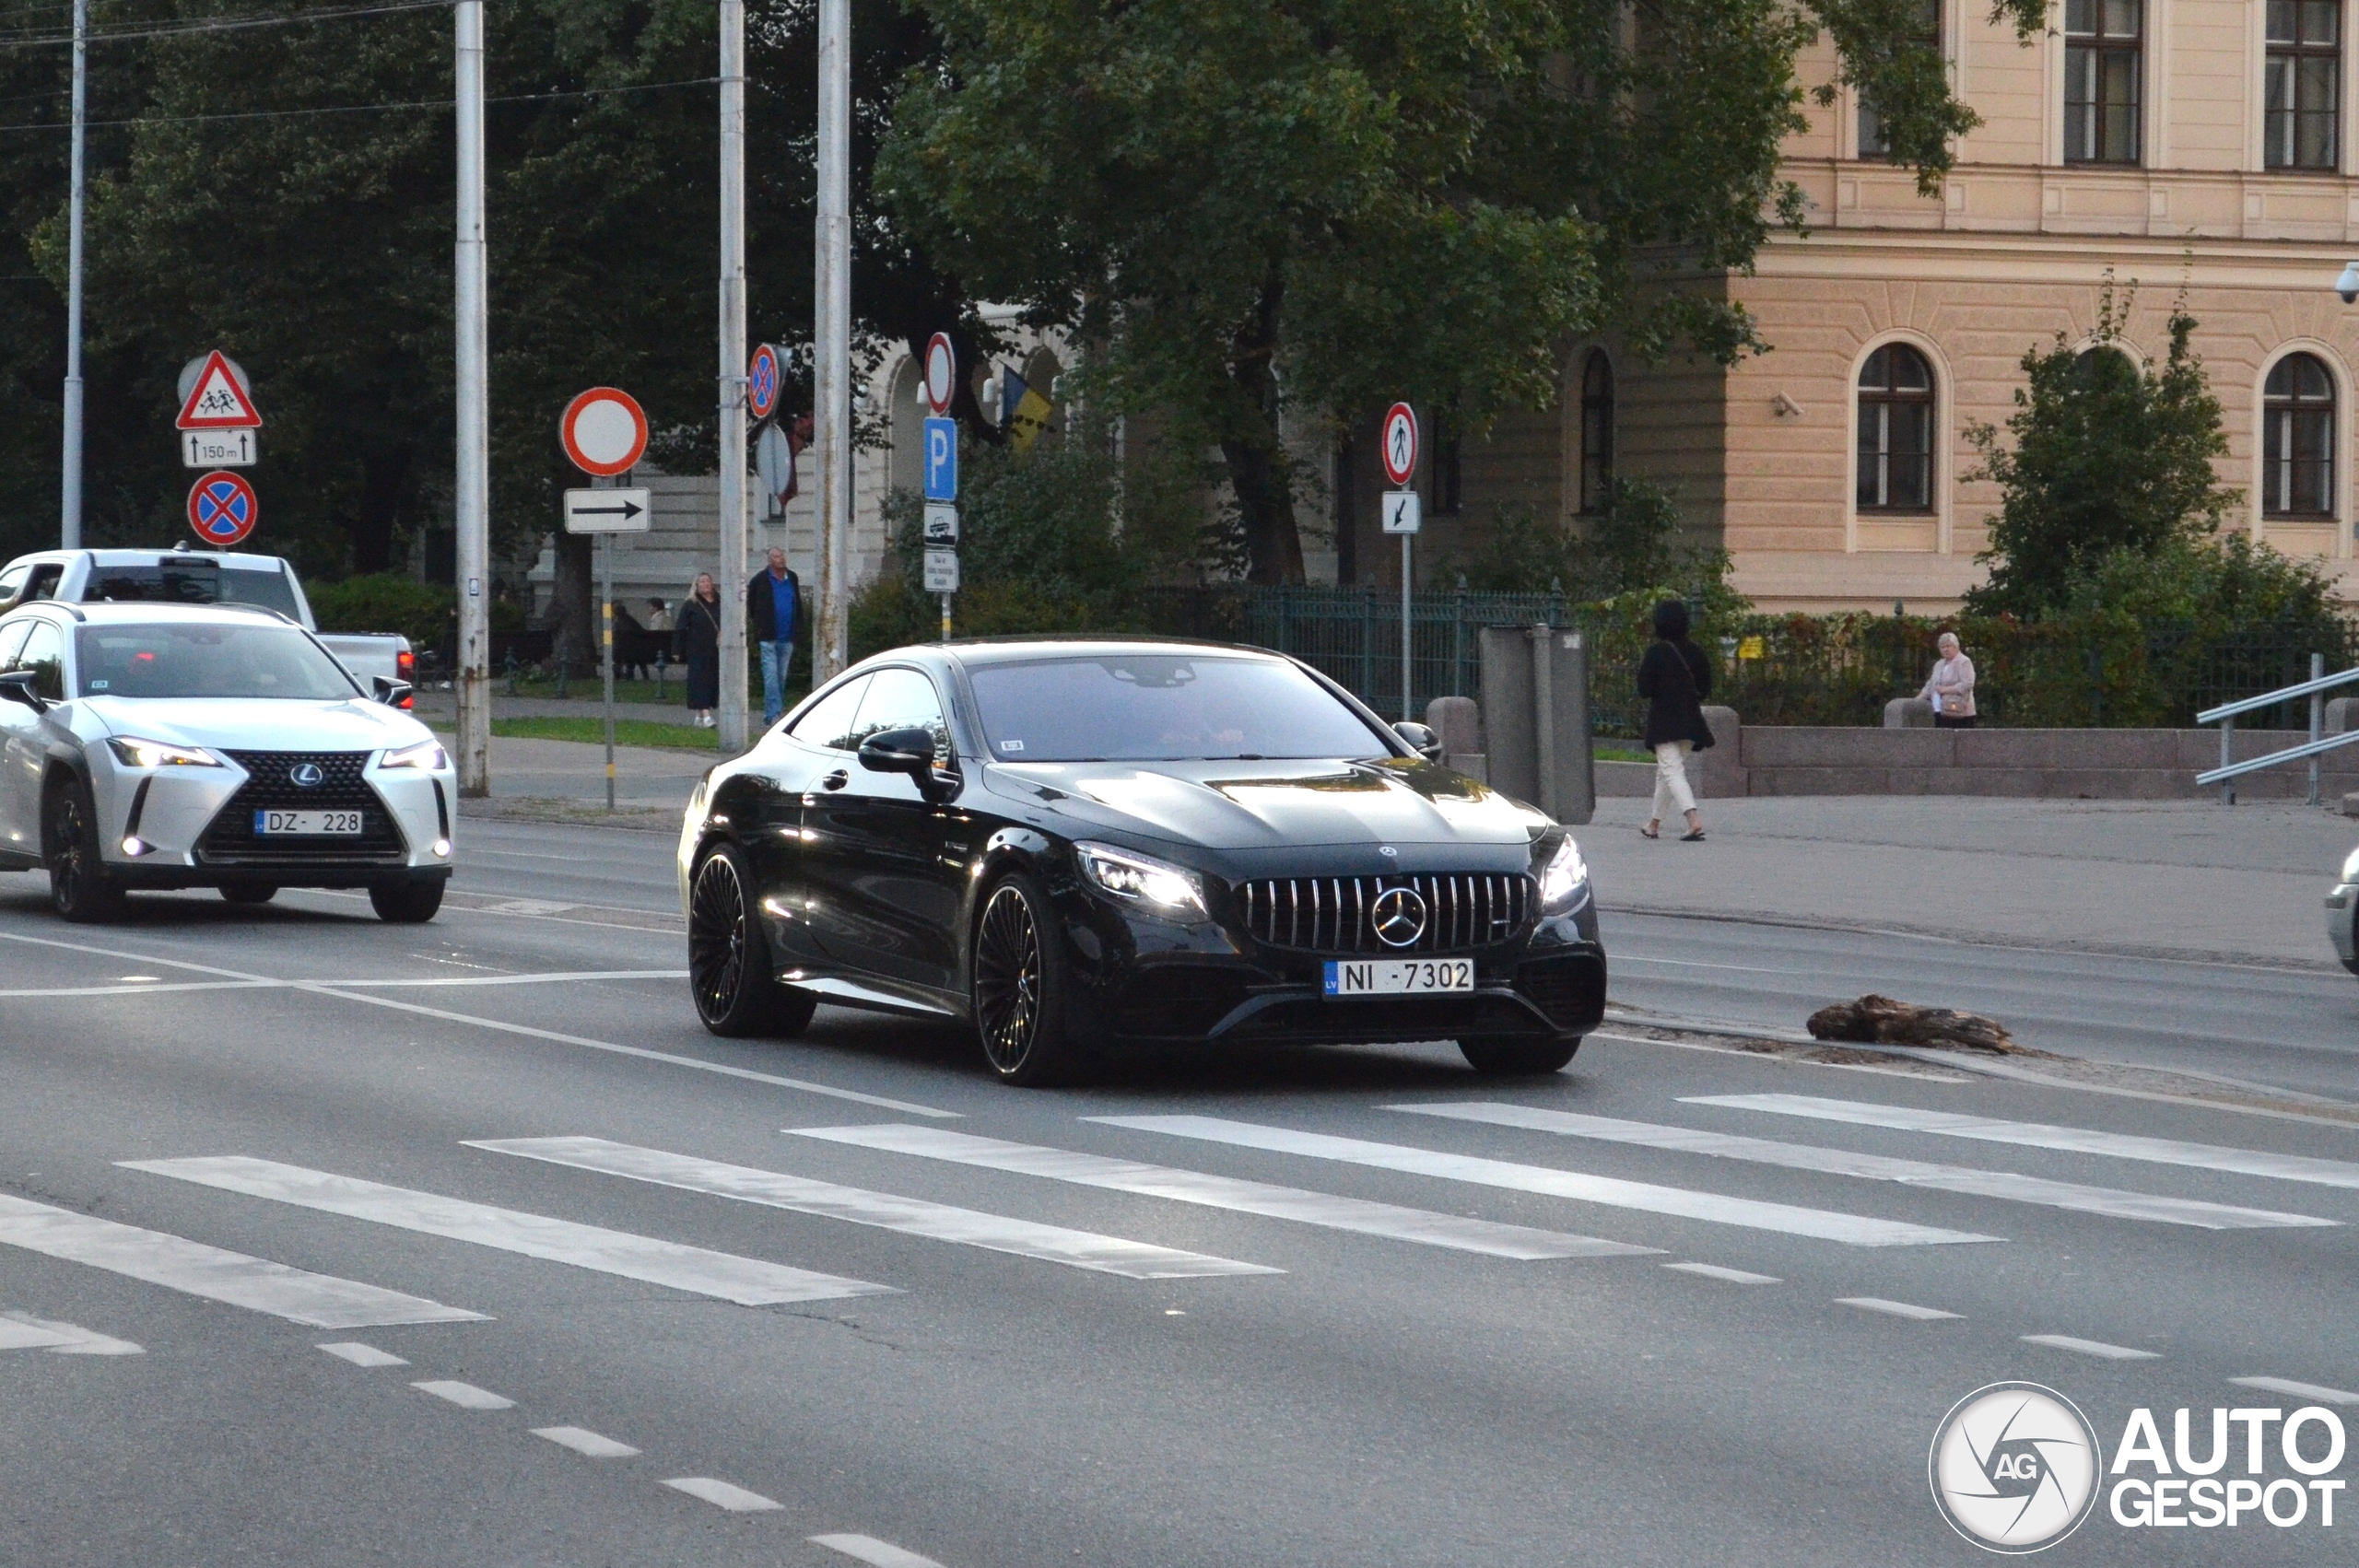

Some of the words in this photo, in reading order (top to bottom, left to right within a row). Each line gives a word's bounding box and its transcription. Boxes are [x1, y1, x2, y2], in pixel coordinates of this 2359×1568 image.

[203, 445, 225, 459] 150
[227, 450, 238, 458] m
[931, 428, 948, 489] P
[323, 813, 359, 831] 228
[1325, 981, 1337, 989] LV
